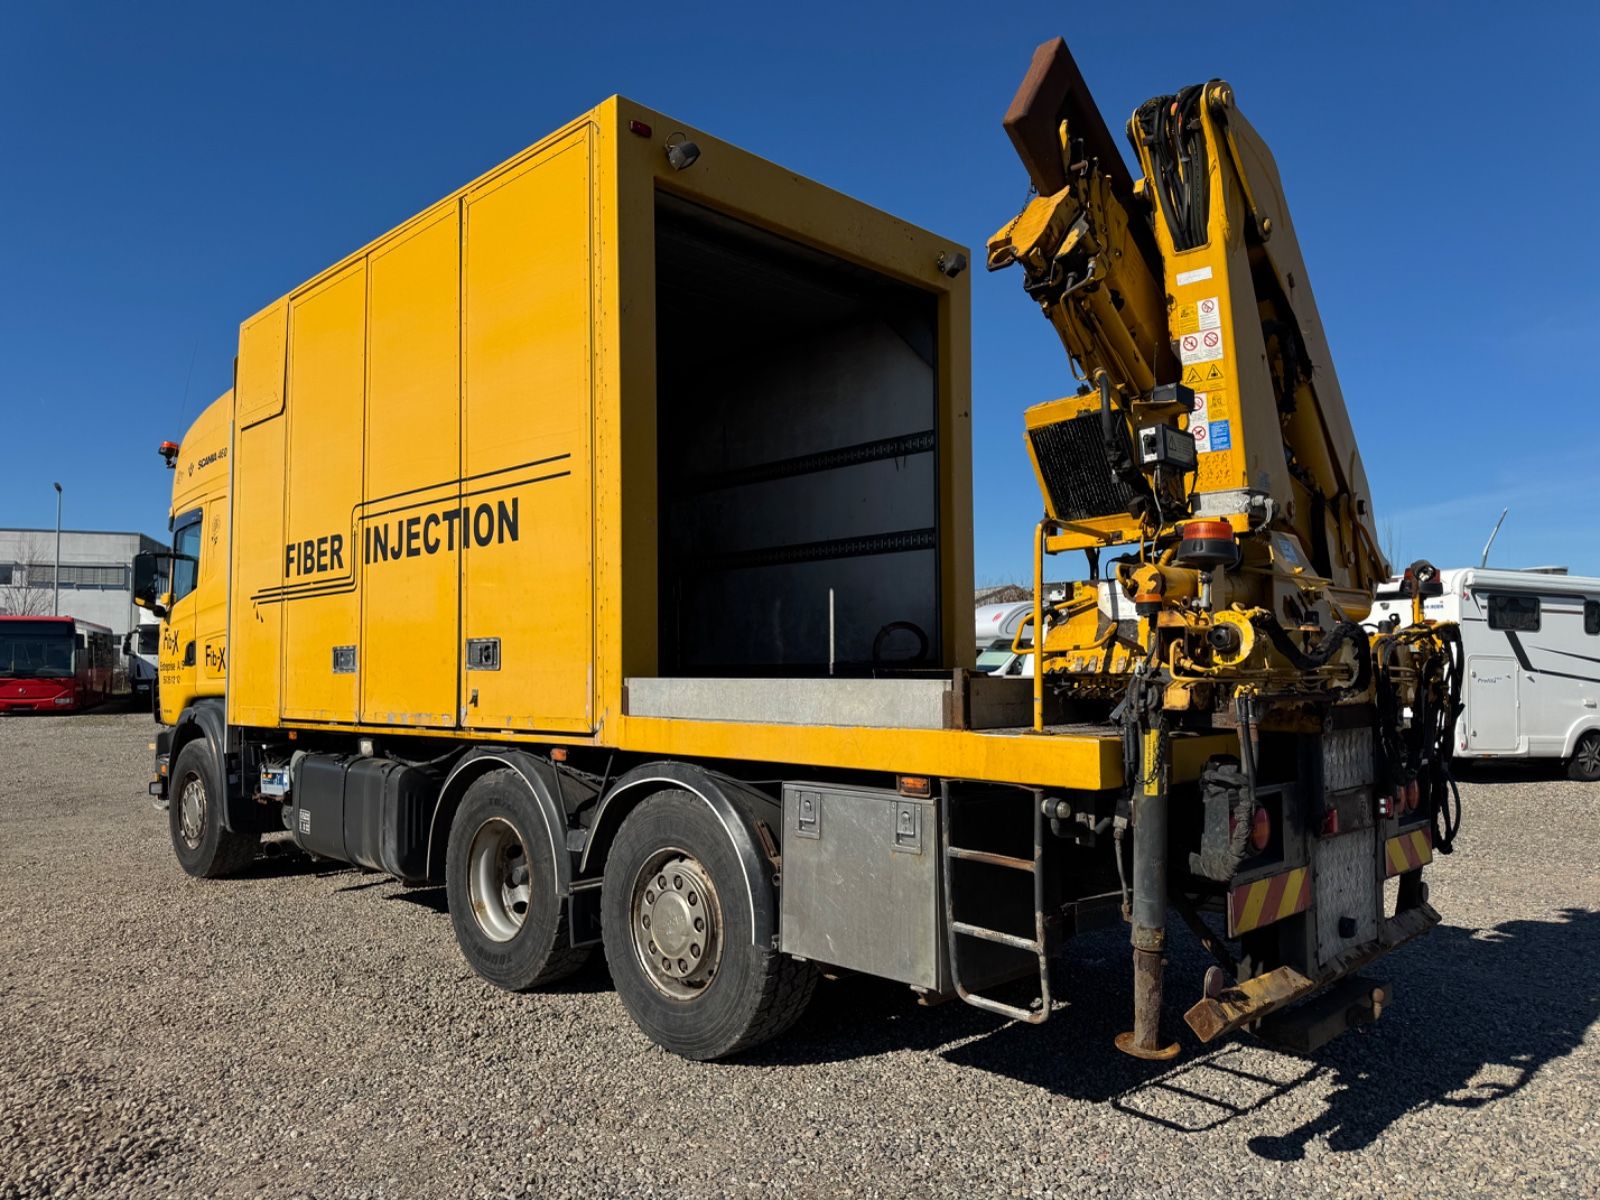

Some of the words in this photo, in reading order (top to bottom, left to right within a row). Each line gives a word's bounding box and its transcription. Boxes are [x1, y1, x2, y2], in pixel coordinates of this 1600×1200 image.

[198, 452, 217, 470] SCANIA
[285, 533, 344, 578] FIBER
[364, 497, 518, 565] INJECTION
[163, 628, 179, 656] Fib-X
[206, 645, 226, 672] Fib-X
